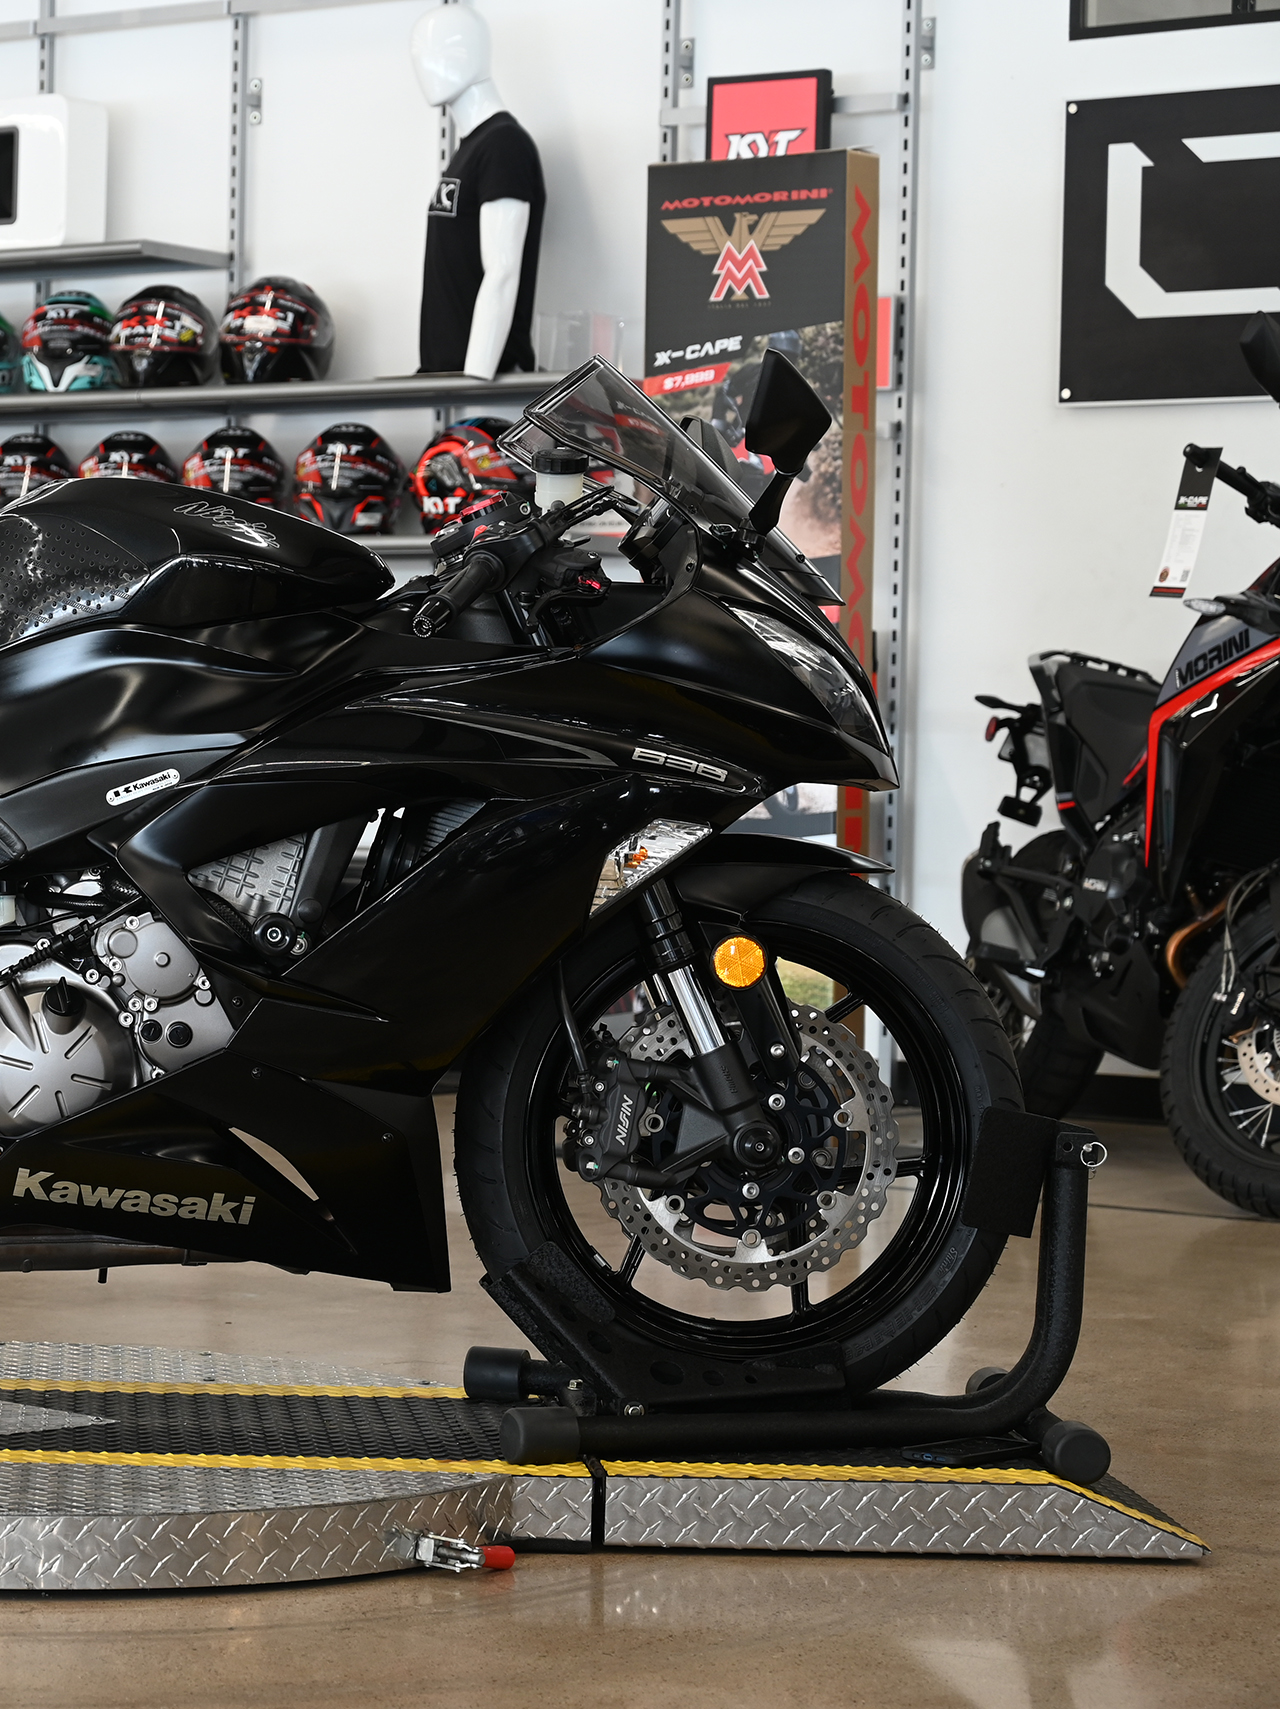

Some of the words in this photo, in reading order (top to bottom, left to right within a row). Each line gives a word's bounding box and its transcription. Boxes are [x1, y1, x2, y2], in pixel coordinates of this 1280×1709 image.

[726, 128, 806, 160] KYT
[653, 335, 744, 368] X-CAPE
[1177, 627, 1251, 686] MORINI
[132, 771, 172, 791] Kawasaki
[631, 747, 729, 783] 636
[615, 1094, 634, 1146] NISSIN
[12, 1167, 257, 1226] Kawasaki
